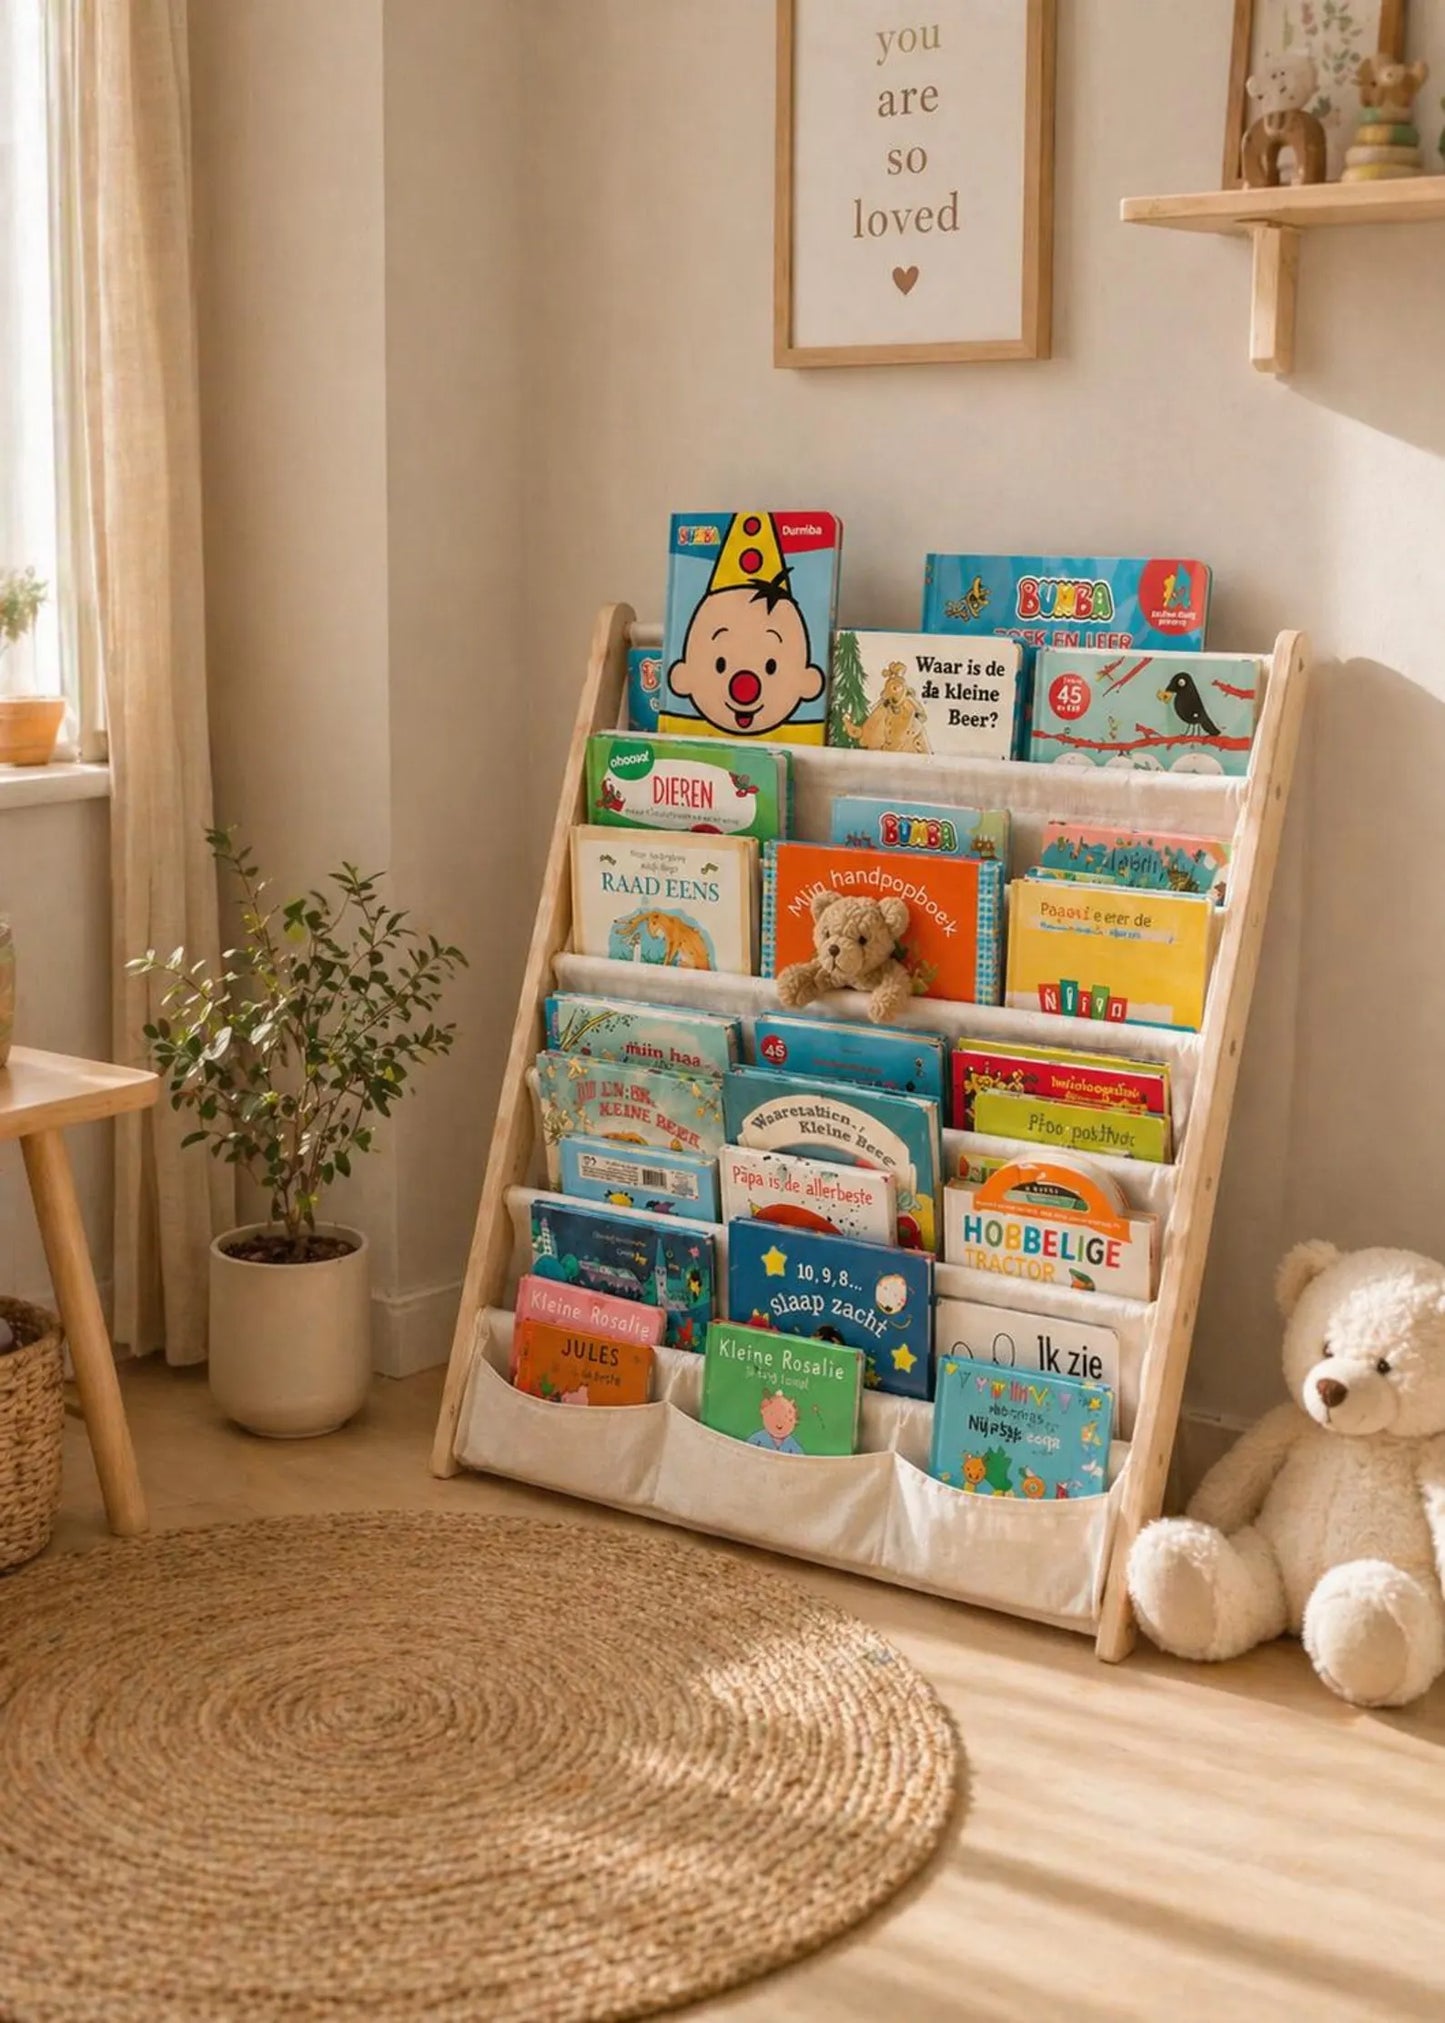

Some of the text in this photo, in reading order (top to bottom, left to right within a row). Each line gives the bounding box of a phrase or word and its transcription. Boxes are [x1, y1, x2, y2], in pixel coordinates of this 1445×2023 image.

[876, 24, 941, 66] you
[877, 84, 940, 118] are
[886, 146, 928, 176] so
[853, 190, 961, 239] loved
[1015, 575, 1115, 622] BUMBA
[916, 656, 1005, 677] Waar is de
[945, 682, 1000, 703] kleine
[1057, 684, 1082, 705] 45
[948, 708, 999, 728] Beer?
[653, 775, 713, 809] DIEREN
[878, 811, 958, 852] BUMBA
[601, 871, 720, 902] RAAD EENS
[1134, 913, 1152, 928] de
[799, 1120, 851, 1143] Kleine
[769, 1174, 780, 1189] is
[785, 1174, 800, 1194] de
[806, 1178, 873, 1206] allerbeste
[964, 1215, 1123, 1268] HOBBELIGE
[965, 1249, 1057, 1283] TRACTOR
[531, 1290, 650, 1342] Kleine Rosalie
[770, 1292, 889, 1339] slaap zacht
[561, 1339, 619, 1367] JULES
[719, 1339, 773, 1367] Kleine
[782, 1350, 844, 1380] Rosalie
[1067, 1346, 1103, 1380] zie
